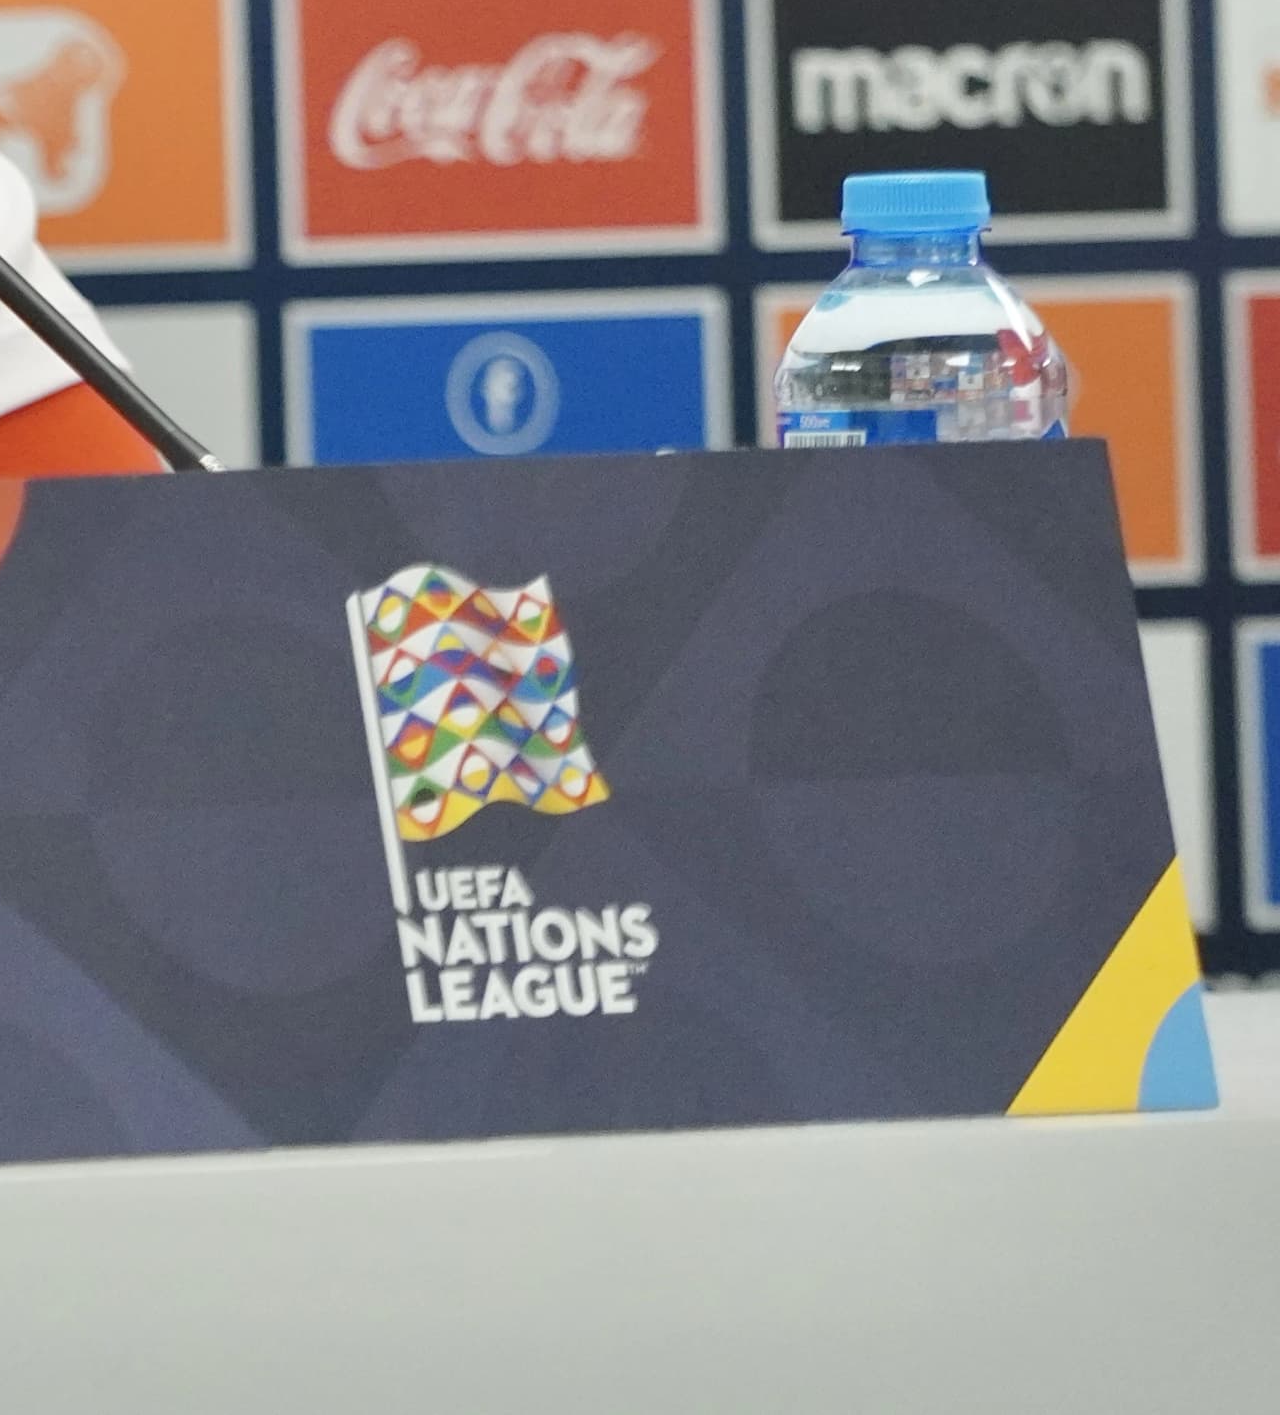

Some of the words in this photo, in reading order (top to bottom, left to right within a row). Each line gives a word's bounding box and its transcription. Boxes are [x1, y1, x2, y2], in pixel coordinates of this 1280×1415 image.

[793, 41, 1149, 131] macron
[416, 867, 532, 910] UEFA
[396, 904, 658, 967] NATIONS
[405, 962, 637, 1022] LEAGUE
